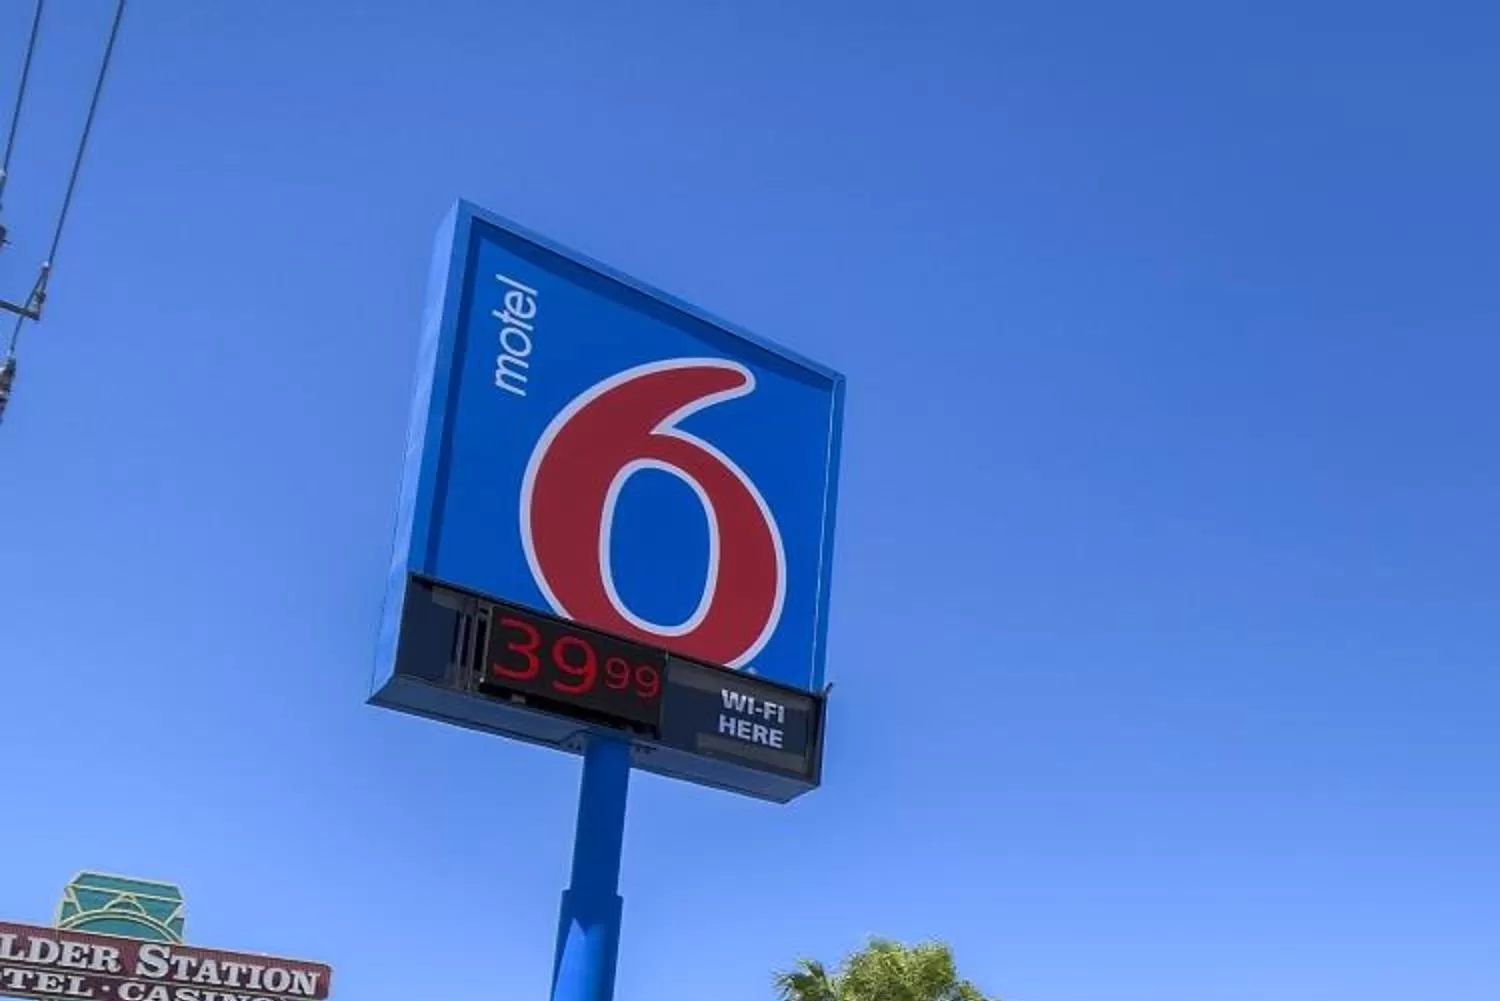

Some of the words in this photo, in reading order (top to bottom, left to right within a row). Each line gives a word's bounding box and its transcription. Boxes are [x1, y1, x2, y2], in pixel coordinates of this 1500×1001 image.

[492, 273, 539, 397] motel
[519, 356, 787, 670] 6
[721, 688, 785, 724] WI-FI
[719, 714, 784, 750] HERE
[0, 967, 93, 998] TEL
[135, 943, 321, 996] STATION
